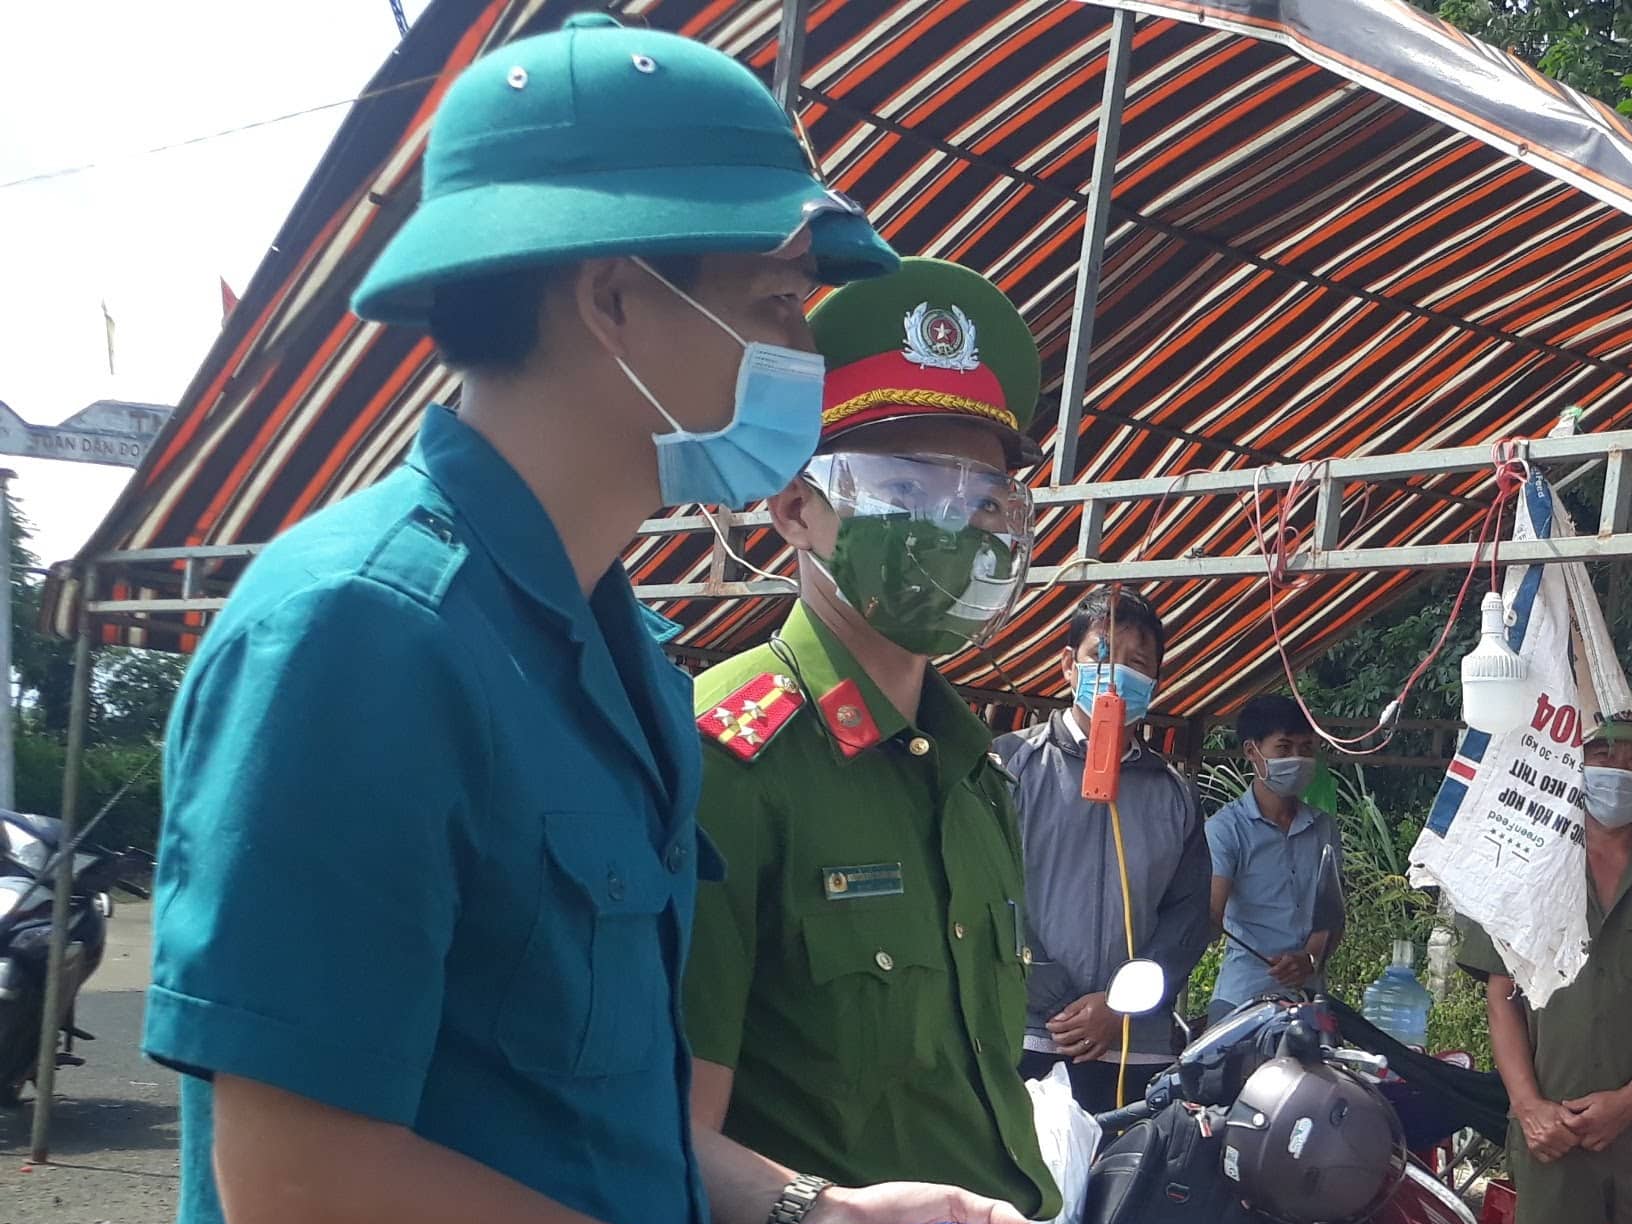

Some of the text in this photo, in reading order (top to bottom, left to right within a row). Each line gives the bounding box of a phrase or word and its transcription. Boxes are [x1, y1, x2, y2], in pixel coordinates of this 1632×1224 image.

[1521, 733, 1538, 750] kg)
[1539, 746, 1552, 761] 30
[1509, 758, 1537, 786] THỊT
[1561, 753, 1575, 770] kg
[1540, 774, 1567, 799] HEO
[1498, 787, 1526, 812] HỢP
[1487, 811, 1545, 848] GreenFeed
